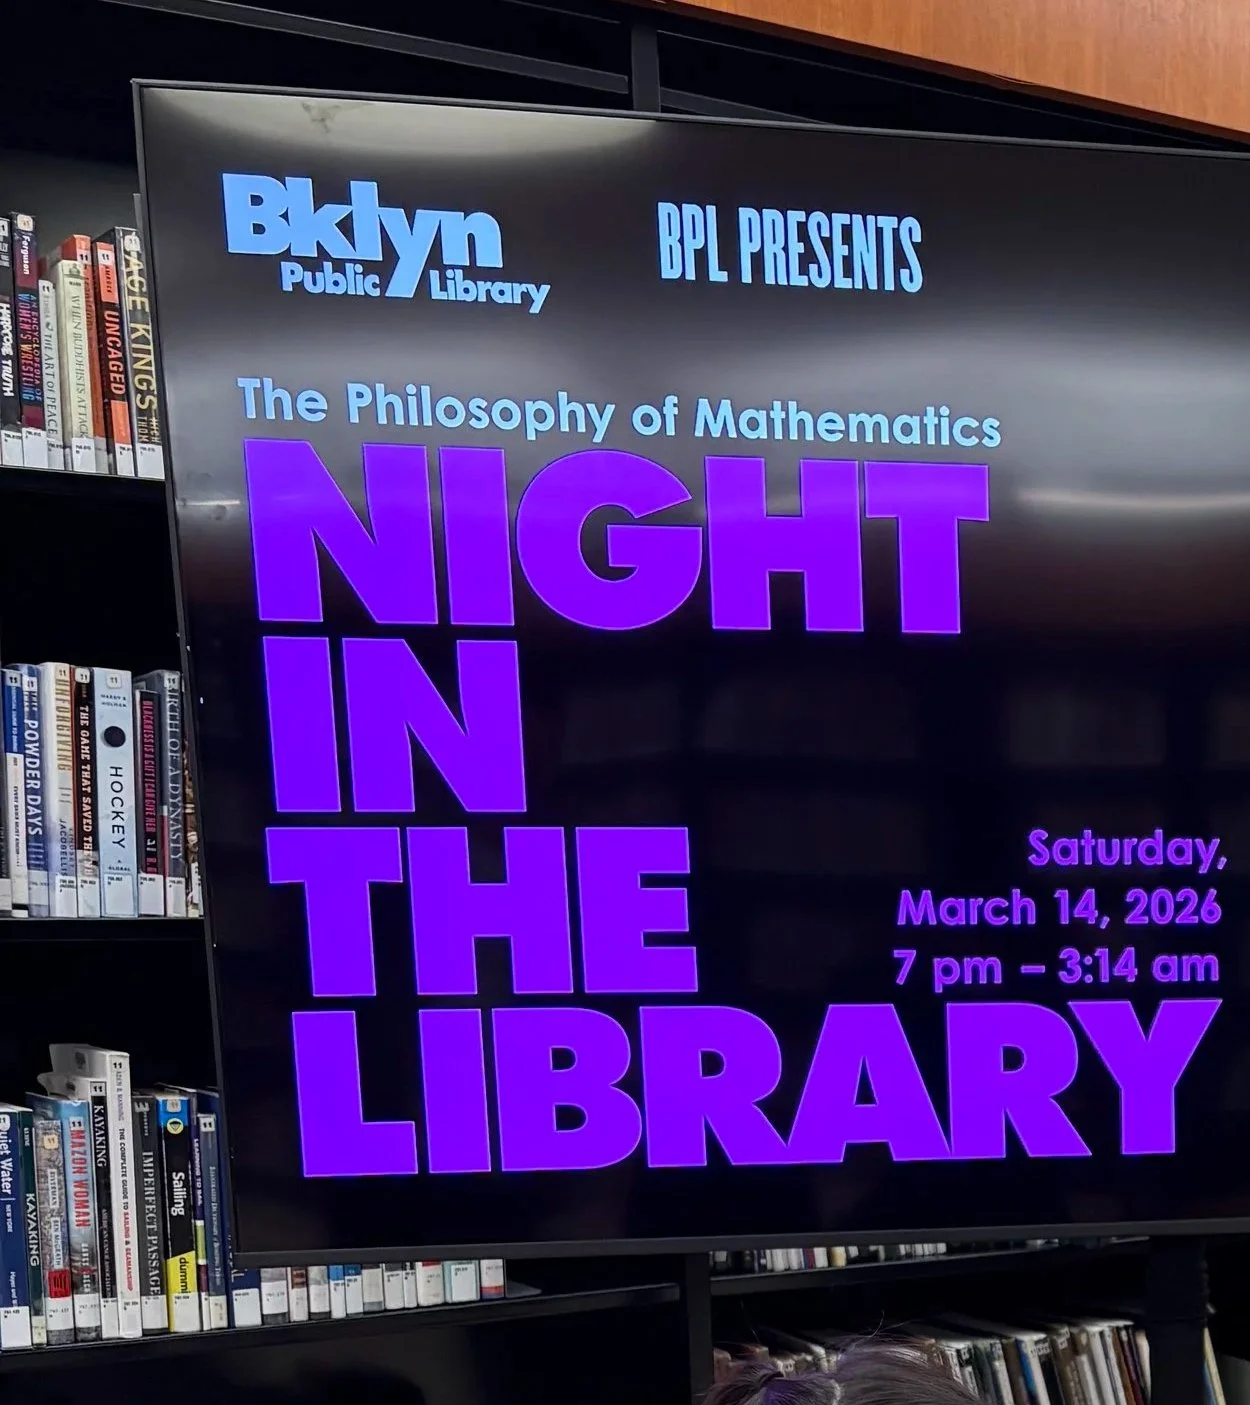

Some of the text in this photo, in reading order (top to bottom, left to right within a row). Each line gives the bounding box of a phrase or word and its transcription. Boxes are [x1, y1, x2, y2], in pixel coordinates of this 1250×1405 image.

[20, 235, 32, 275] Ferguson
[221, 172, 503, 299] Bklyn
[657, 202, 923, 293] BPL PRESENTS
[281, 262, 551, 314] Public Library
[18, 293, 34, 401] WOMEN'S WRESTLING
[32, 311, 41, 385] ENCYCLOPEDIA
[71, 295, 87, 394] WHEN BUDDHISTS
[104, 311, 126, 395] UNCAGED
[130, 322, 157, 410] KINGS
[45, 354, 58, 435] ART PEACE
[236, 376, 1001, 448] The Philosophy of Mathematics
[243, 437, 990, 635] NIGHT
[55, 679, 71, 772] UNFORGIVING
[79, 706, 89, 726] THE
[80, 730, 90, 760] GAME
[263, 636, 526, 813] IN
[24, 719, 39, 788] POWDER
[81, 765, 91, 792] THAT
[27, 795, 42, 836] DAYS
[82, 796, 92, 831] SAVED
[109, 766, 125, 849] HOCKEY
[168, 738, 183, 862] OF DYNASTY
[59, 819, 68, 876] JACOBELLIS
[83, 836, 92, 856] THE
[1027, 828, 1227, 872] Saturday,
[266, 826, 698, 996] THE
[897, 887, 1223, 931] March 14, 2026
[892, 946, 1220, 993] 7 pm 3:14 am
[292, 999, 1223, 1177] LIBRARY
[94, 1105, 107, 1167] KAYAKING
[119, 1142, 127, 1178] COMPLETE
[1, 1161, 12, 1194] Water
[74, 1179, 91, 1228] WOMAN
[121, 1179, 129, 1200] GUIDE
[142, 1151, 158, 1231] IMPERFECT
[171, 1171, 187, 1216] Sailing
[26, 1193, 40, 1267] KAYAKING
[123, 1211, 131, 1239] SAILING
[124, 1247, 133, 1292] SEAMANSHIP
[146, 1235, 161, 1295] PASSAGE
